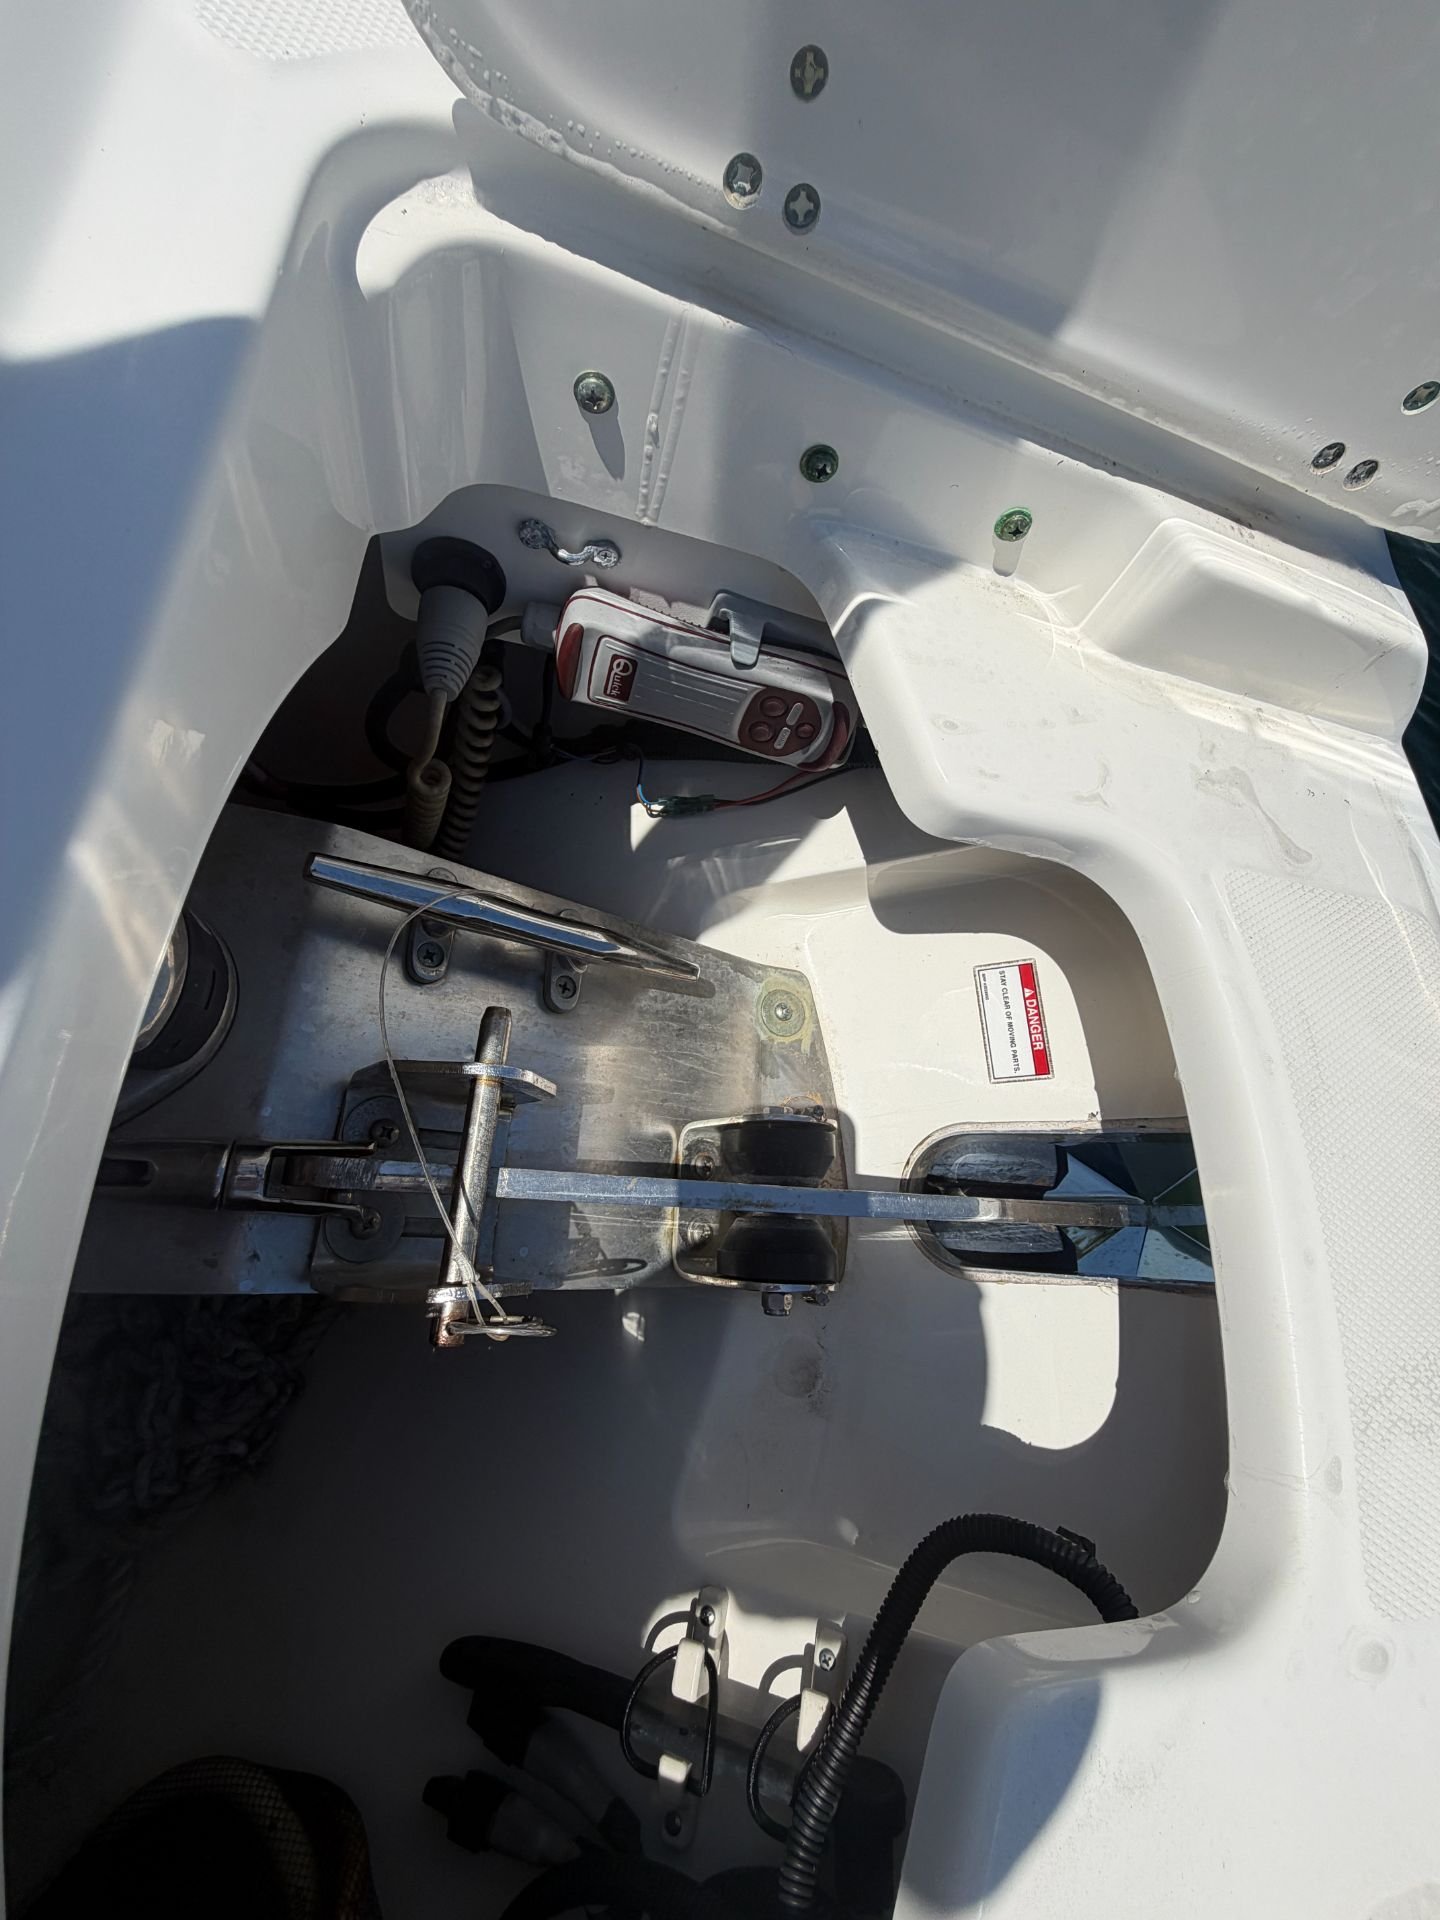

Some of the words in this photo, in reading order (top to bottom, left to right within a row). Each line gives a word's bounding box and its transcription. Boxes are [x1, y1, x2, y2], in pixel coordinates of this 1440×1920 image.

[607, 658, 633, 697] Quick
[999, 970, 1007, 987] STAY
[1002, 987, 1011, 1010] CLEAR
[1005, 1011, 1012, 1021] OF
[1025, 998, 1044, 1051] DANGER
[1007, 1021, 1017, 1048] MOVING
[1011, 1049, 1020, 1074] PARTS.
